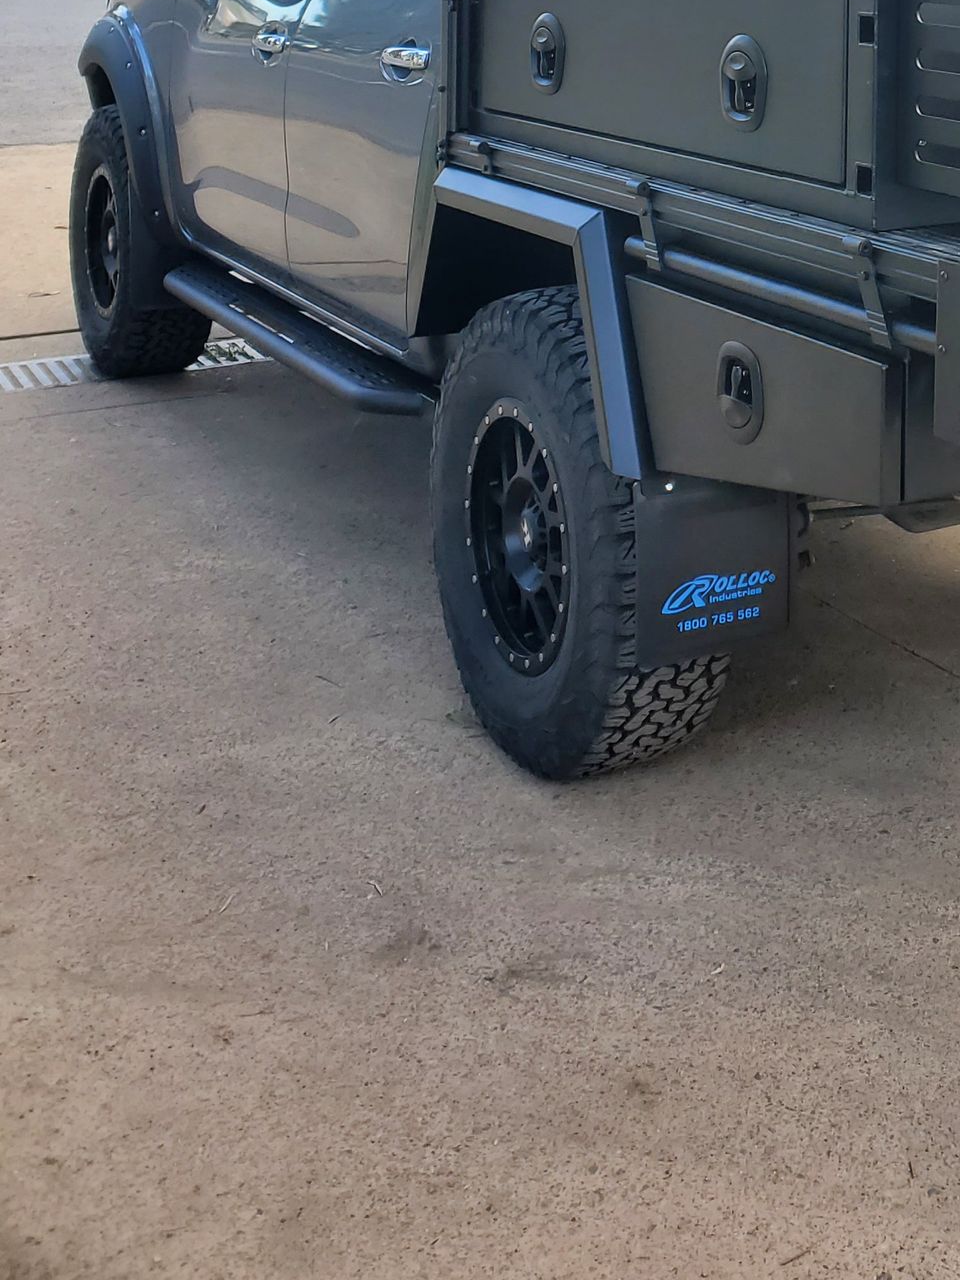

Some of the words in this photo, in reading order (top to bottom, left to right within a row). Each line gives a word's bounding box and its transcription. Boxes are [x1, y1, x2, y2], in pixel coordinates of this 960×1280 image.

[709, 587, 762, 604] Industries
[677, 617, 707, 632] 1800
[711, 612, 734, 625] 765
[737, 607, 760, 620] 562
